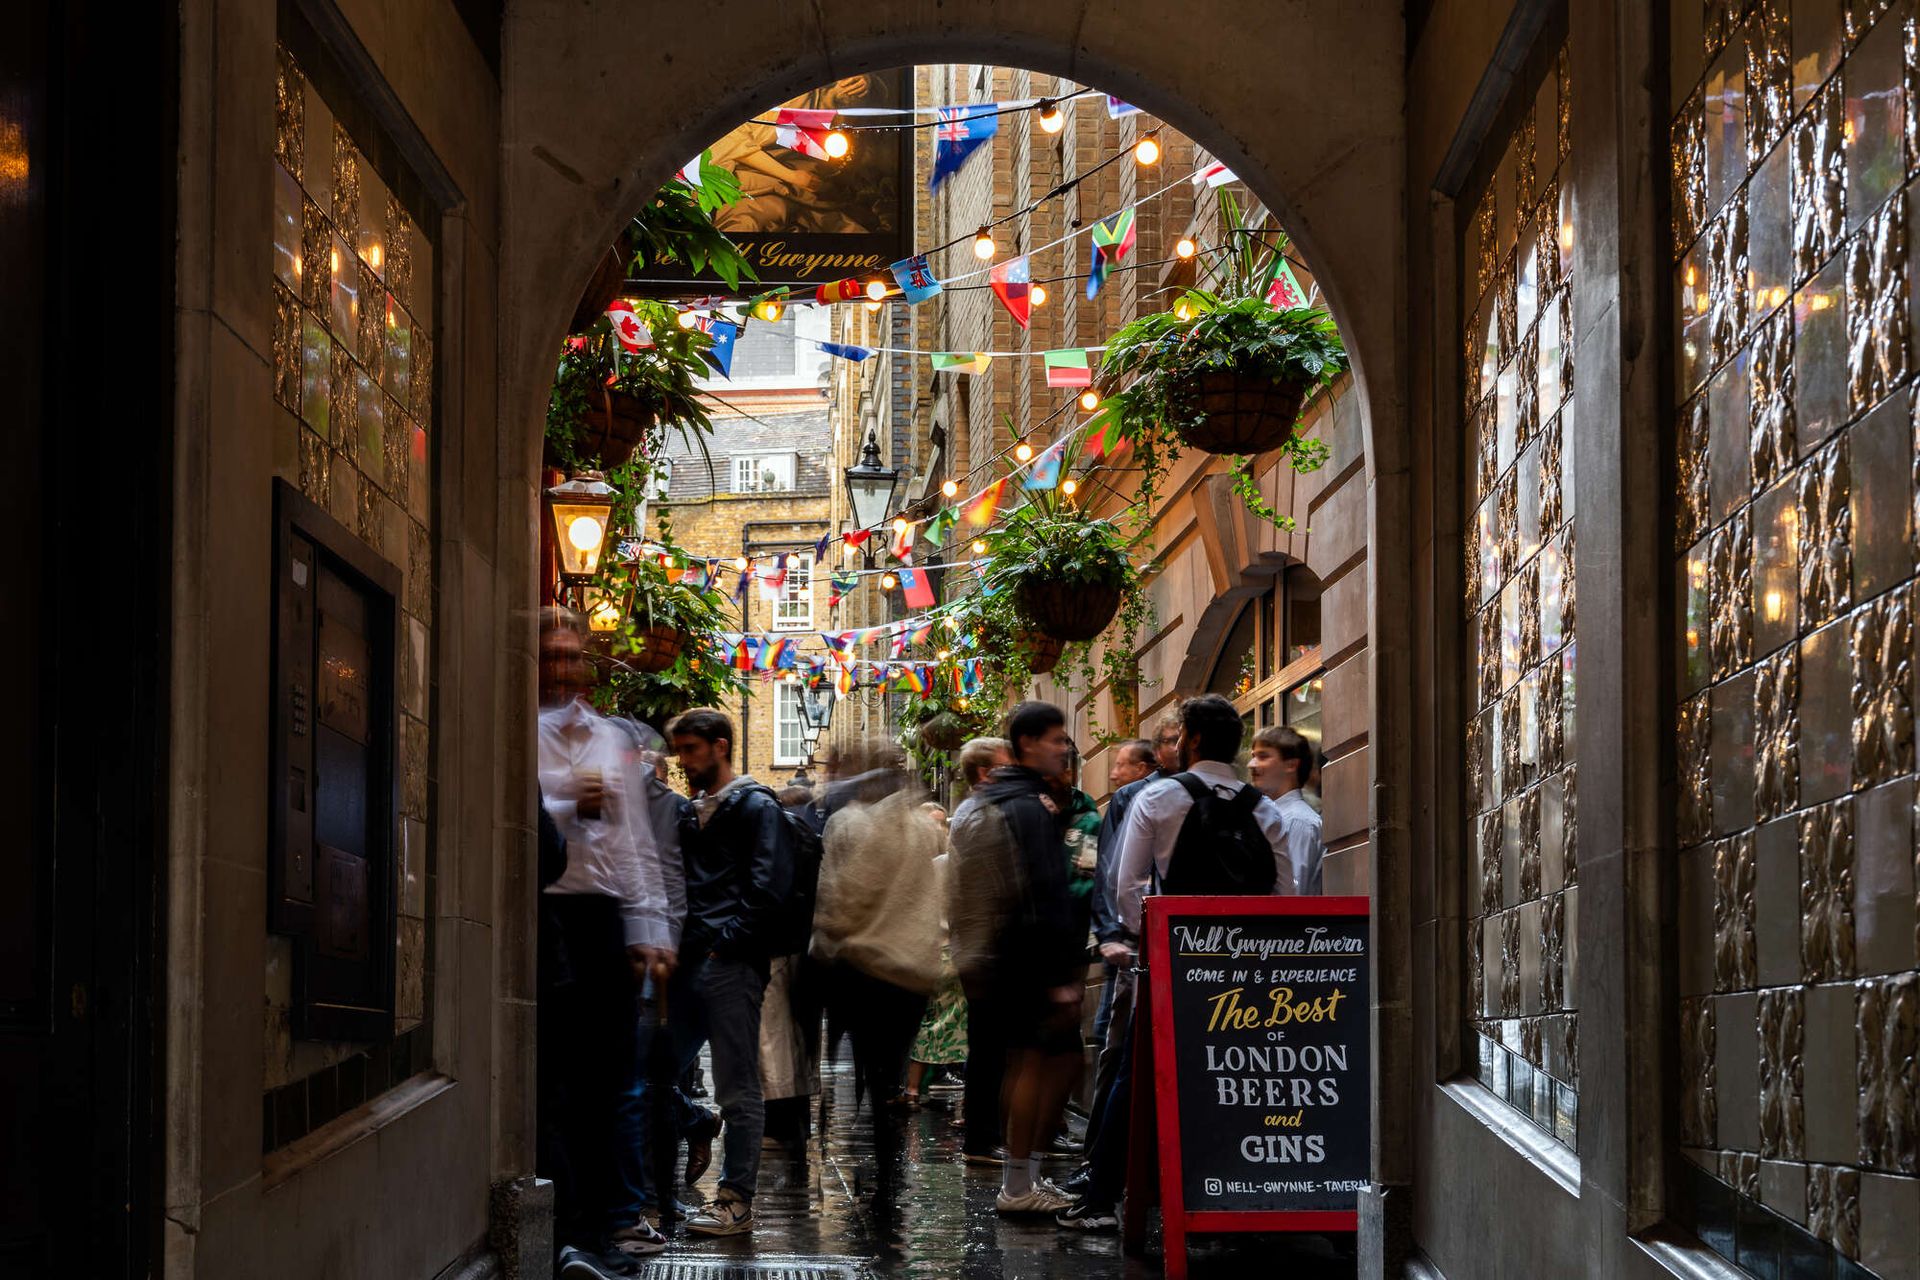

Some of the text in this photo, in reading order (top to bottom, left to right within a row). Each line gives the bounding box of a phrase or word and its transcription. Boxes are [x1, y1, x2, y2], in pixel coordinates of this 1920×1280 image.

[760, 241, 882, 278] Gwynne
[1174, 926, 1364, 960] Nell Gwynne Tavern
[1186, 967, 1356, 984] COME IN & EXPERIENCE
[1208, 988, 1346, 1031] The Best
[1266, 1031, 1286, 1042] OF
[1206, 1045, 1347, 1072] LONDON
[1216, 1077, 1339, 1106] BEERS
[1265, 1110, 1303, 1127] and
[1241, 1135, 1325, 1163] GINS
